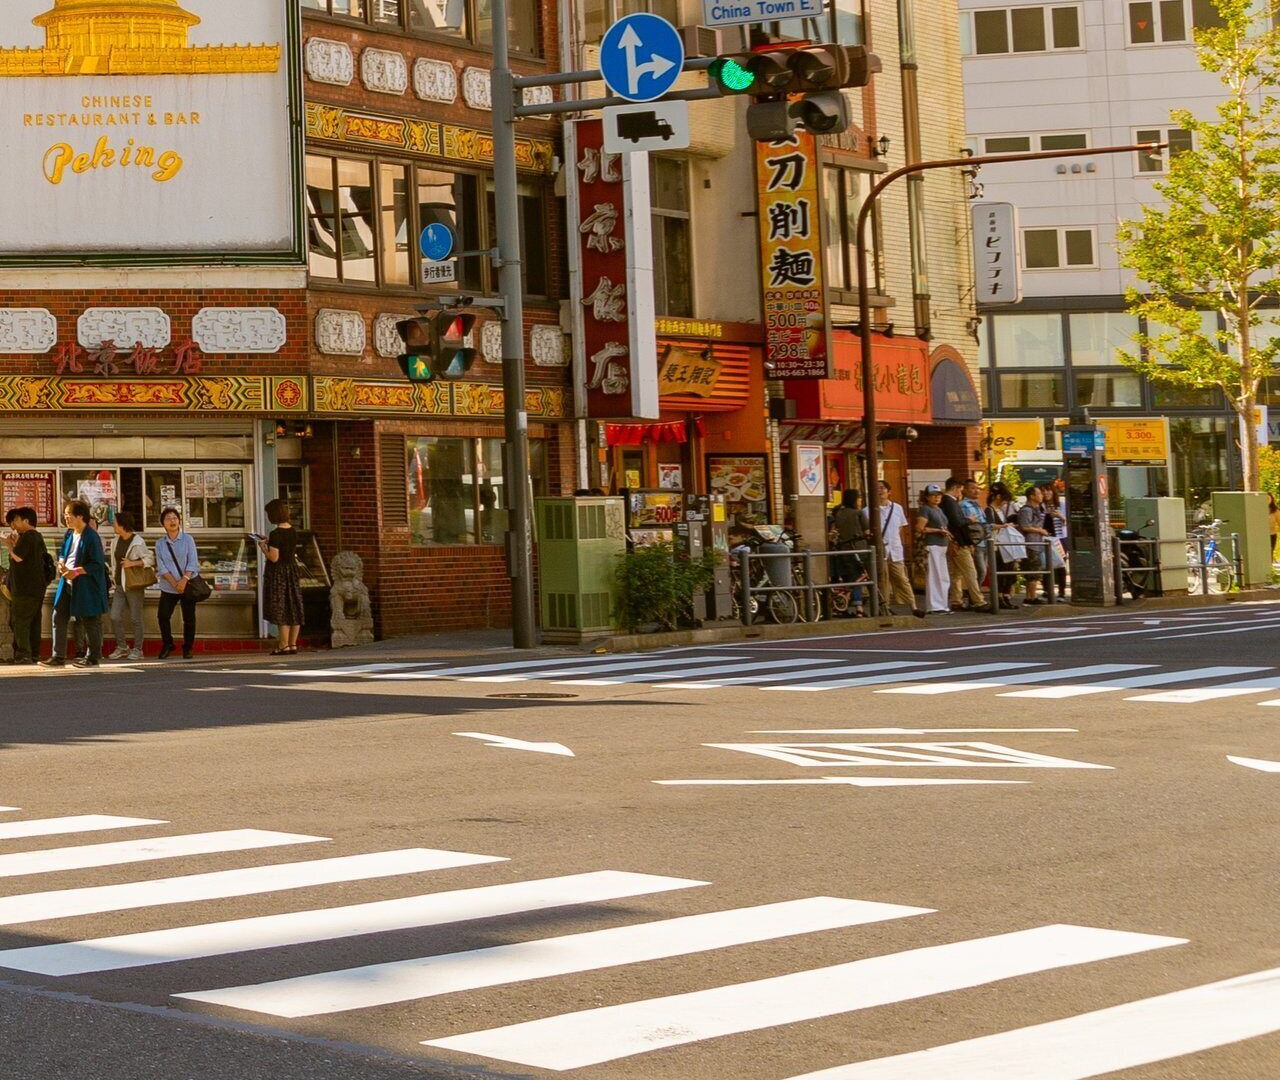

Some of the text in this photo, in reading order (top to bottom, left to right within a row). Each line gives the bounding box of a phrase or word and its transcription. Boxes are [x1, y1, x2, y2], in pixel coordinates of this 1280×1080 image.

[711, 5, 751, 20] China
[757, 1, 795, 15] Town
[81, 95, 153, 108] CHINESE
[23, 111, 200, 126] RESTAURANT & BAR
[42, 135, 183, 184] Peking
[424, 265, 452, 280] 歩行者優先
[576, 144, 630, 397] 北京飯店
[768, 312, 807, 328] 500円
[768, 330, 811, 342] 生ビール
[52, 338, 204, 375] 北京飯店
